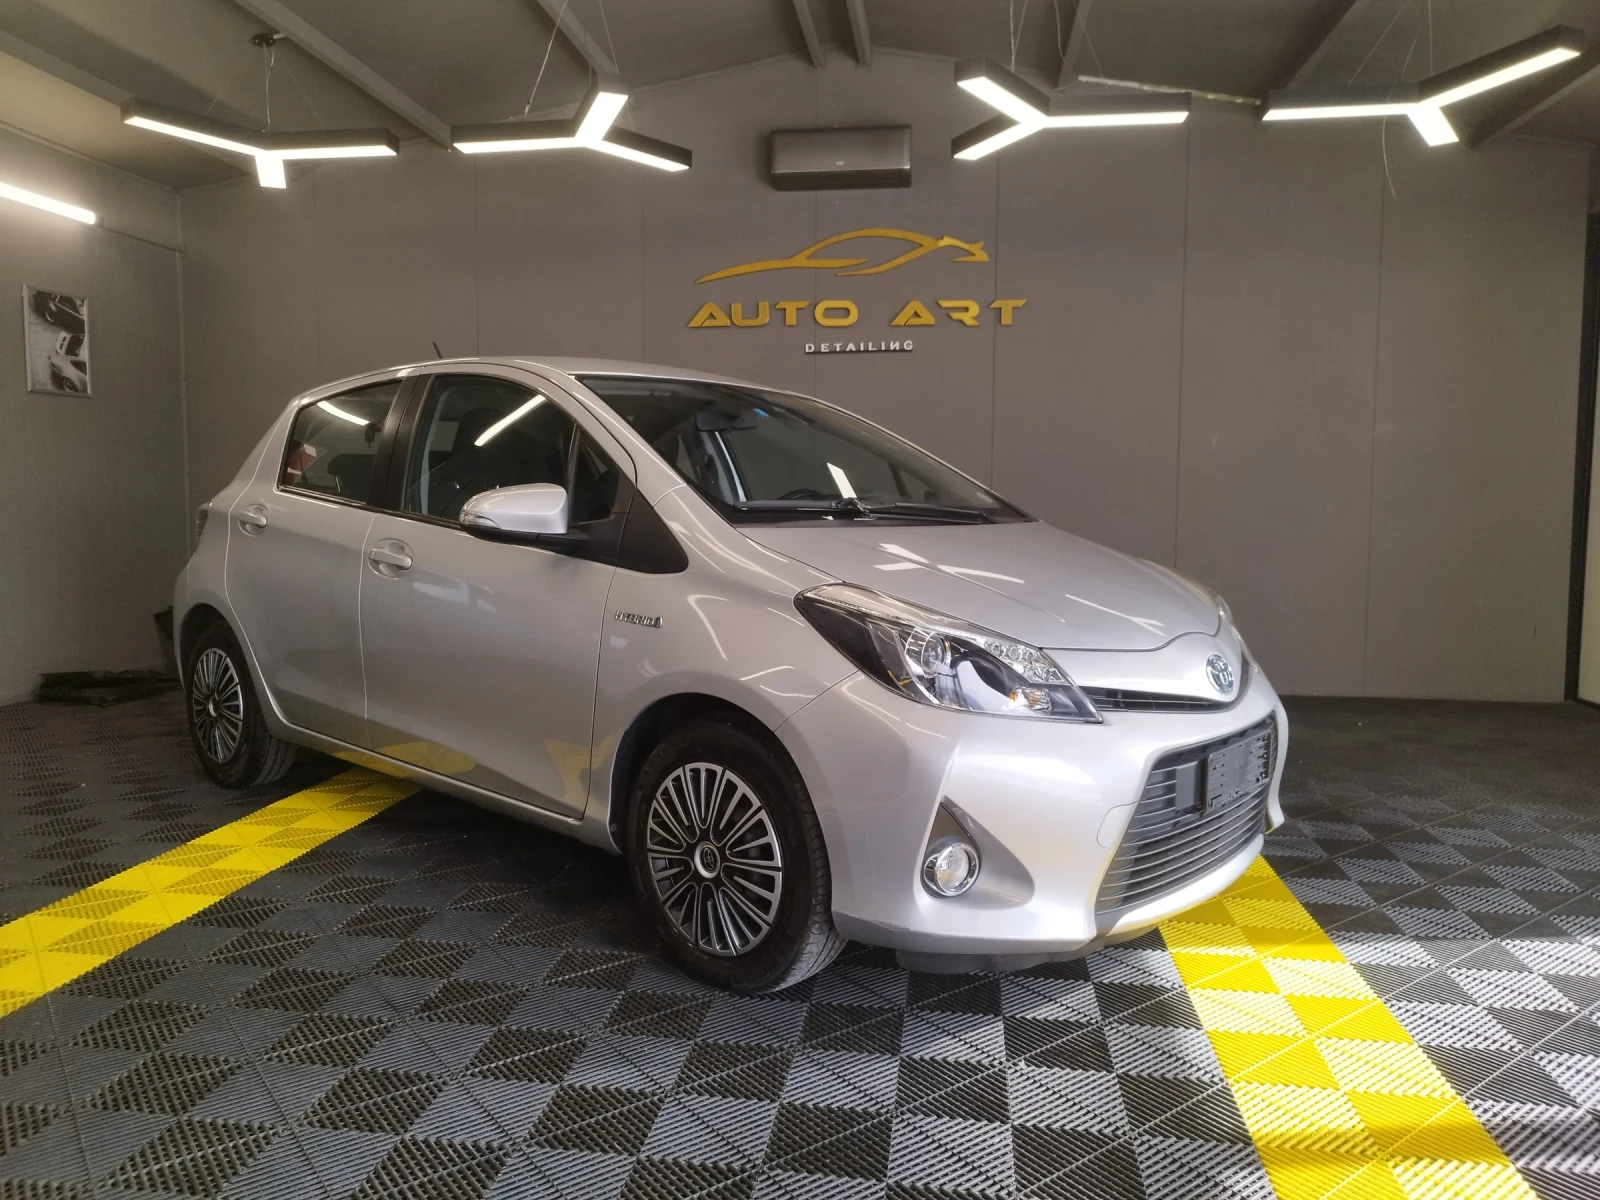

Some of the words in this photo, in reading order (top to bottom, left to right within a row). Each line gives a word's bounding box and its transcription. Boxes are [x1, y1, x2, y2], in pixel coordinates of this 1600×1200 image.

[688, 299, 859, 327] AUTO
[890, 299, 1027, 327] ART
[805, 340, 914, 354] DETAILING
[615, 610, 656, 628] HYBRID
